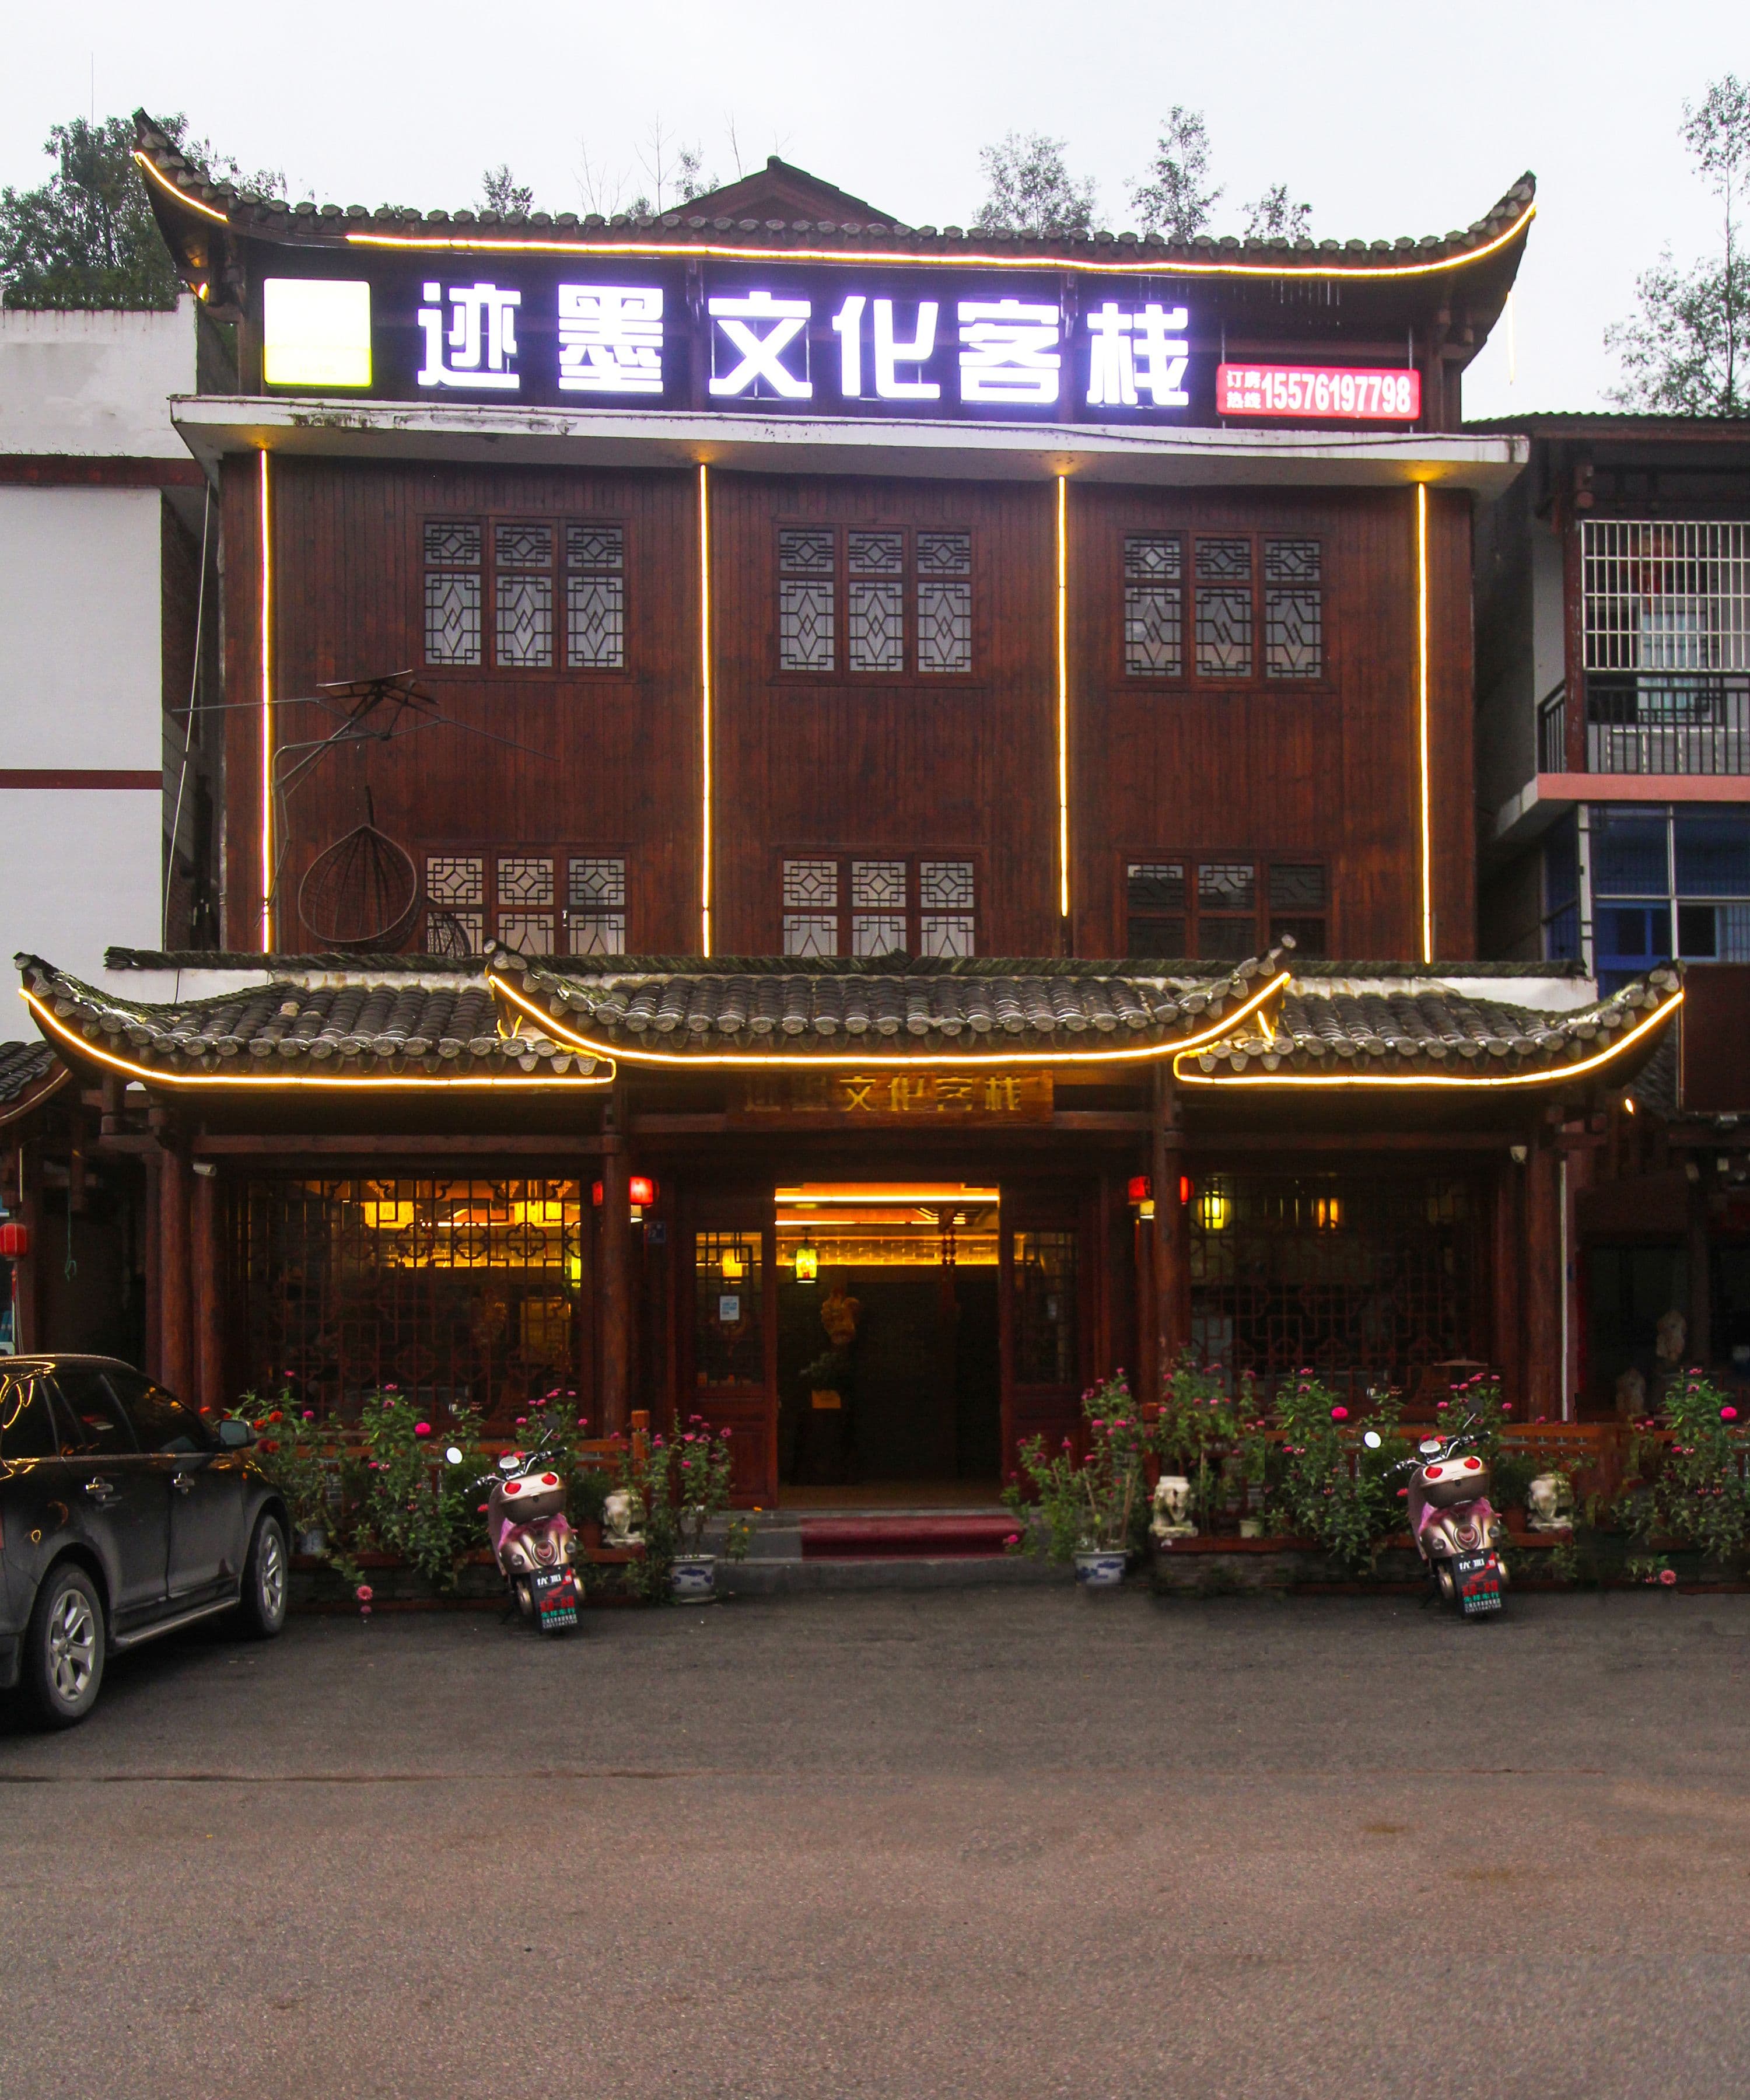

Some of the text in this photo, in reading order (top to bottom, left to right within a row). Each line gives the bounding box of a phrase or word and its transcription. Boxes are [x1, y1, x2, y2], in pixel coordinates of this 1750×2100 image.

[416, 281, 1189, 406] 迹墨文化客栈
[1227, 370, 1261, 387] 订房
[1262, 372, 1410, 413] 15576197798
[1227, 391, 1261, 409] 热线
[745, 1076, 1021, 1111] 文化客栈
